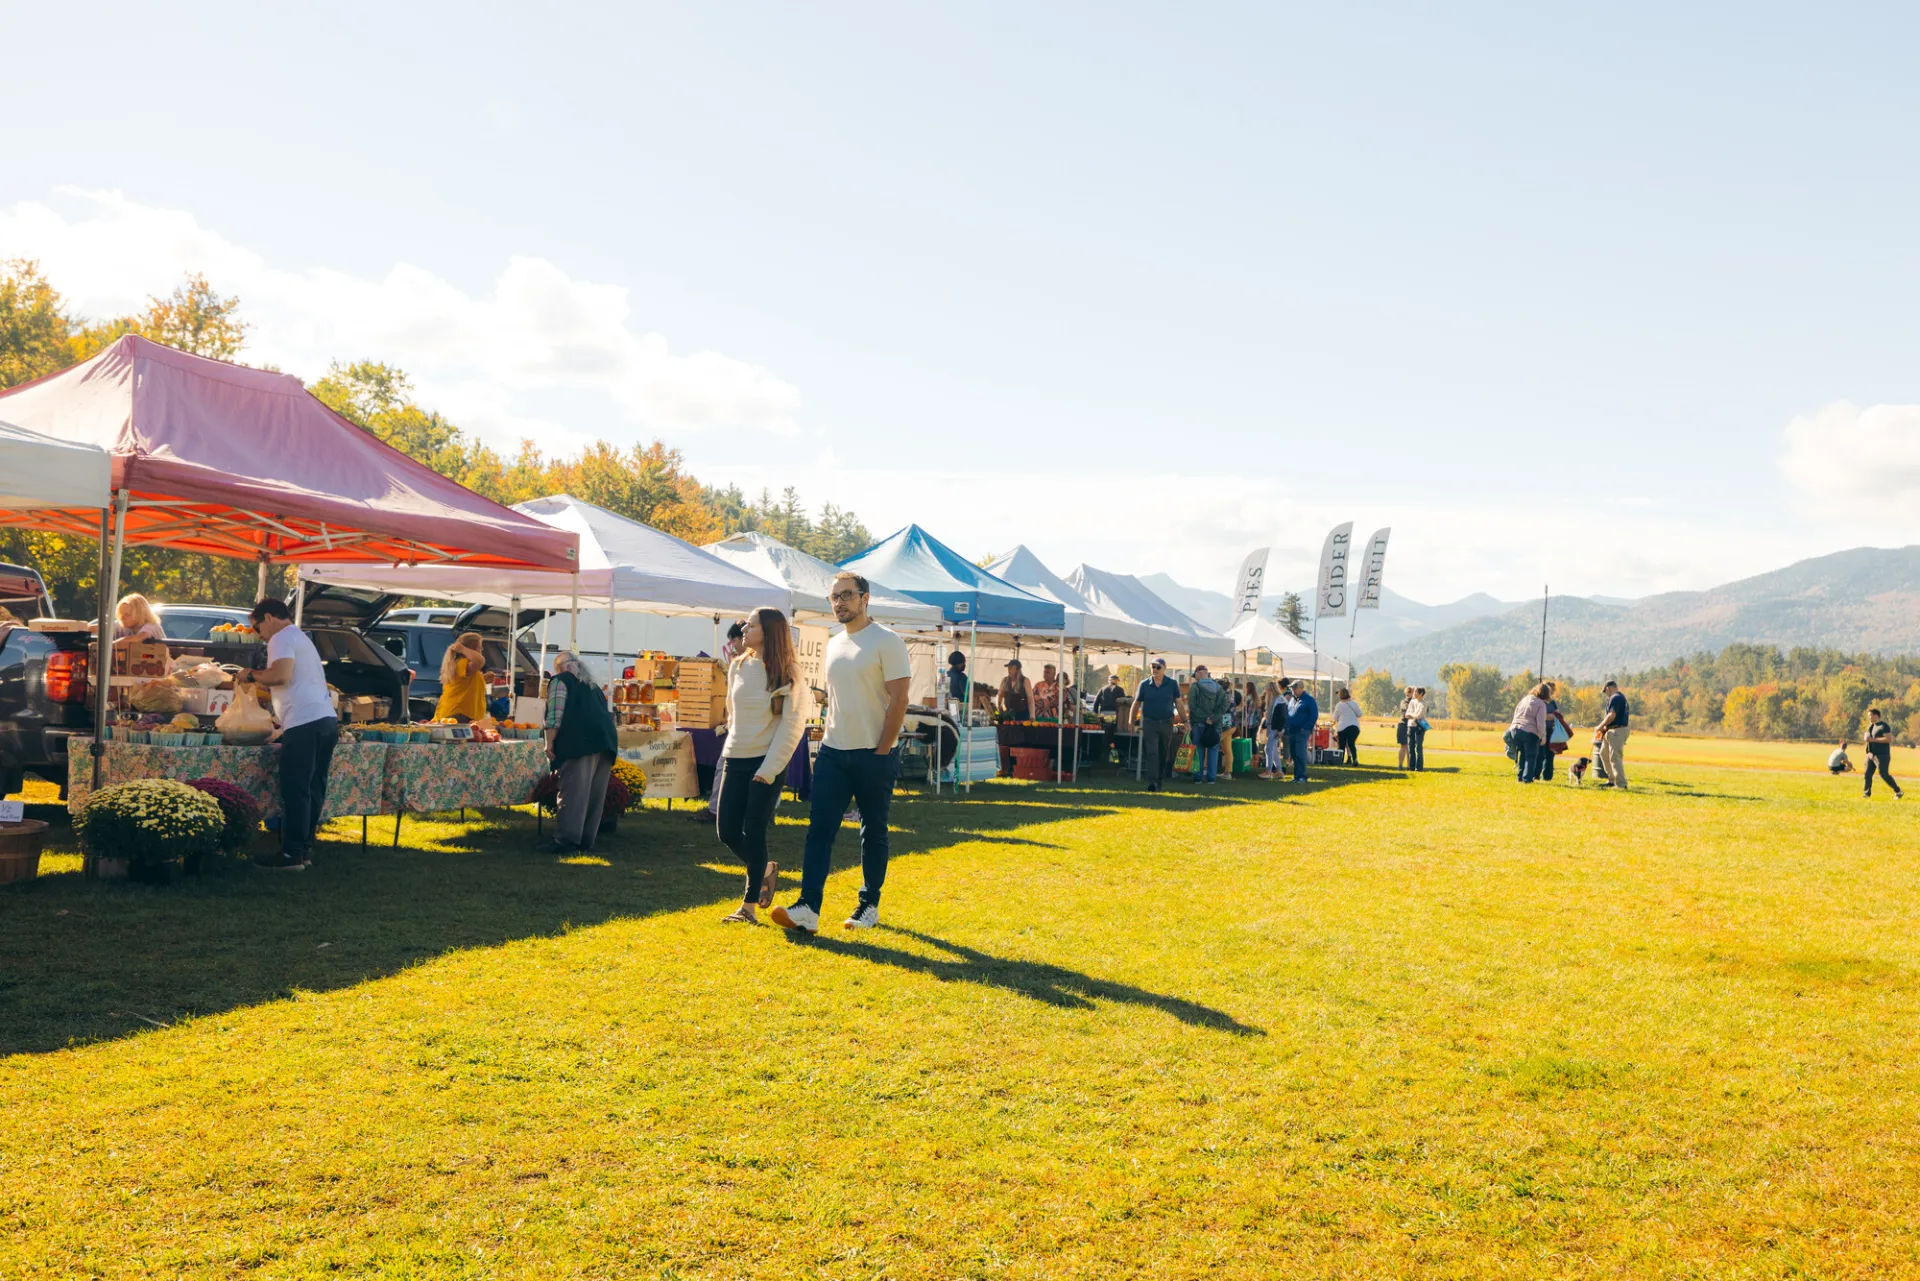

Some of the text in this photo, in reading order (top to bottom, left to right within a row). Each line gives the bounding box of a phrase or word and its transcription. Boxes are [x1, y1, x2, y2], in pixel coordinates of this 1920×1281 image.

[1242, 567, 1262, 613] PIES
[1326, 533, 1348, 609] CIDER
[1366, 536, 1385, 601] FRUIT
[796, 640, 821, 657] LUE
[800, 661, 819, 674] PPER
